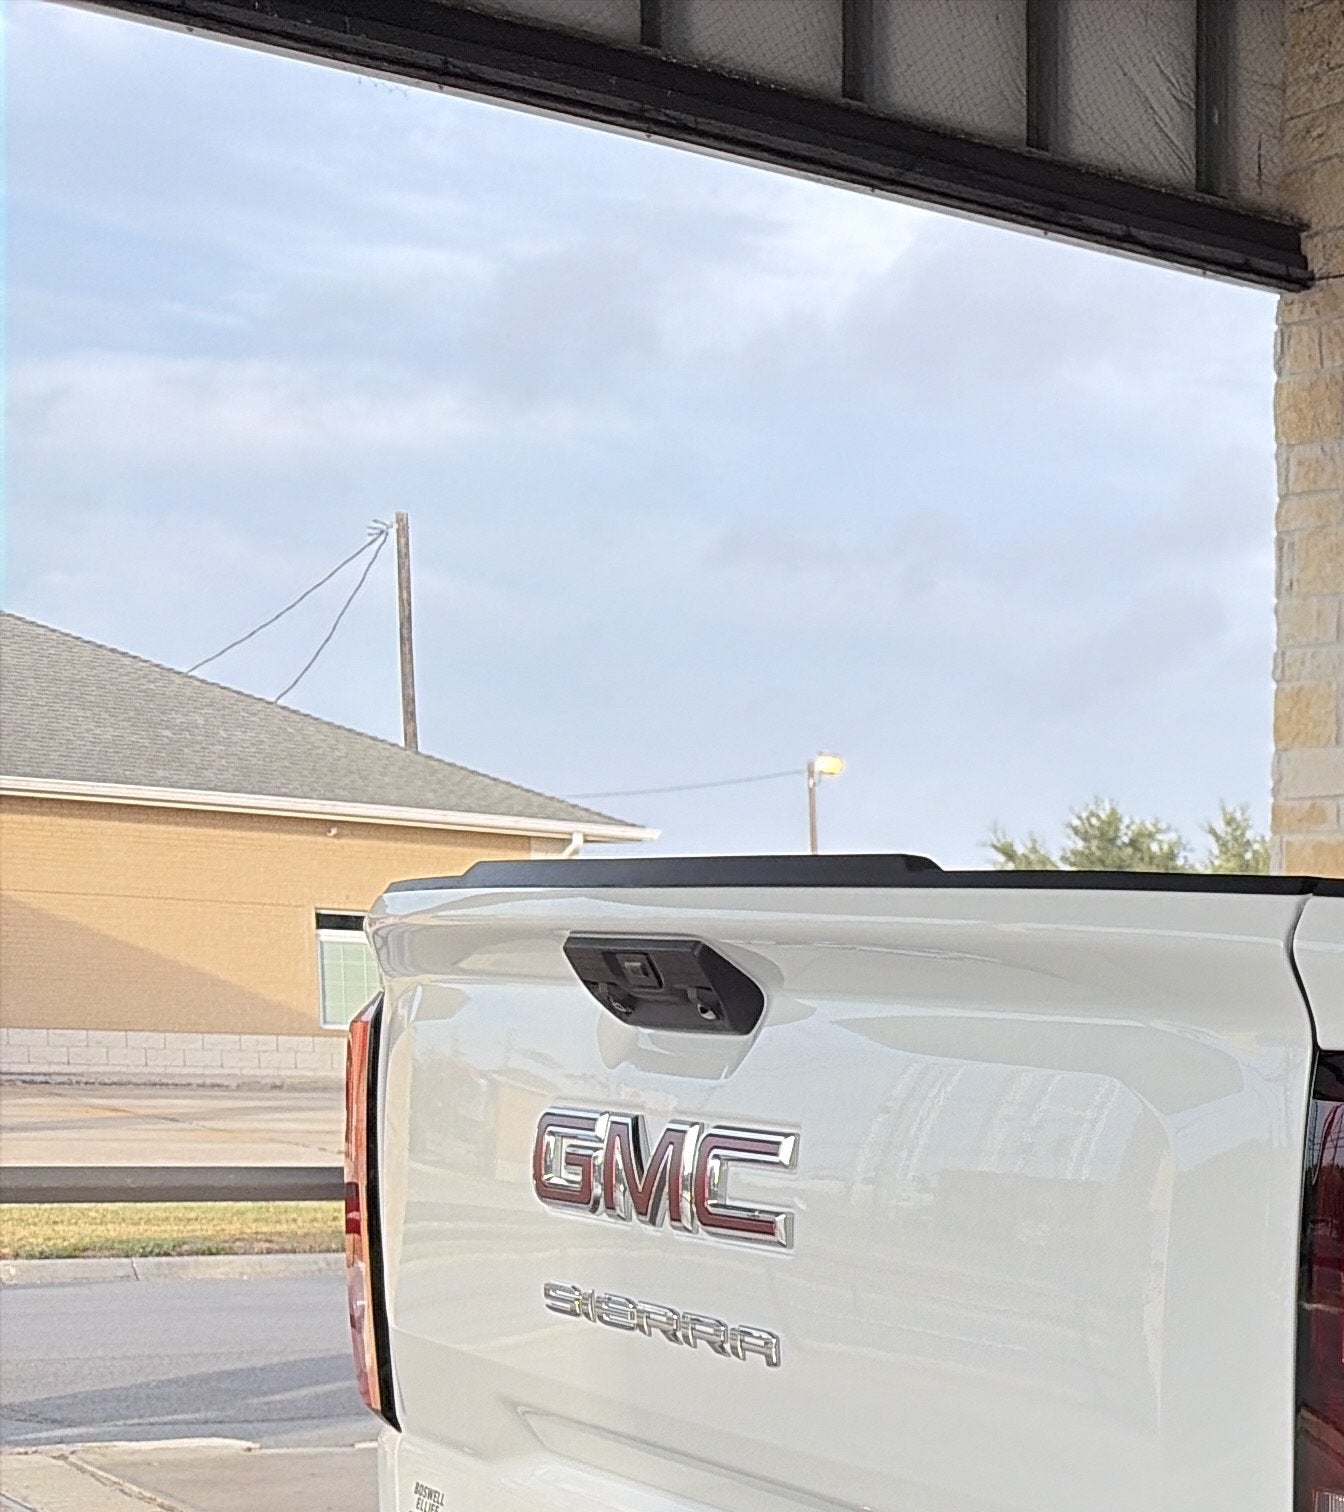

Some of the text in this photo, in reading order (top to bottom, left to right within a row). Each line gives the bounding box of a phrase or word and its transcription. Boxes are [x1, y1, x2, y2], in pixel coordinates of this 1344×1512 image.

[532, 1105, 800, 1250] GMC
[543, 1281, 781, 1367] SIERRA
[414, 1481, 444, 1506] BOSWELL
